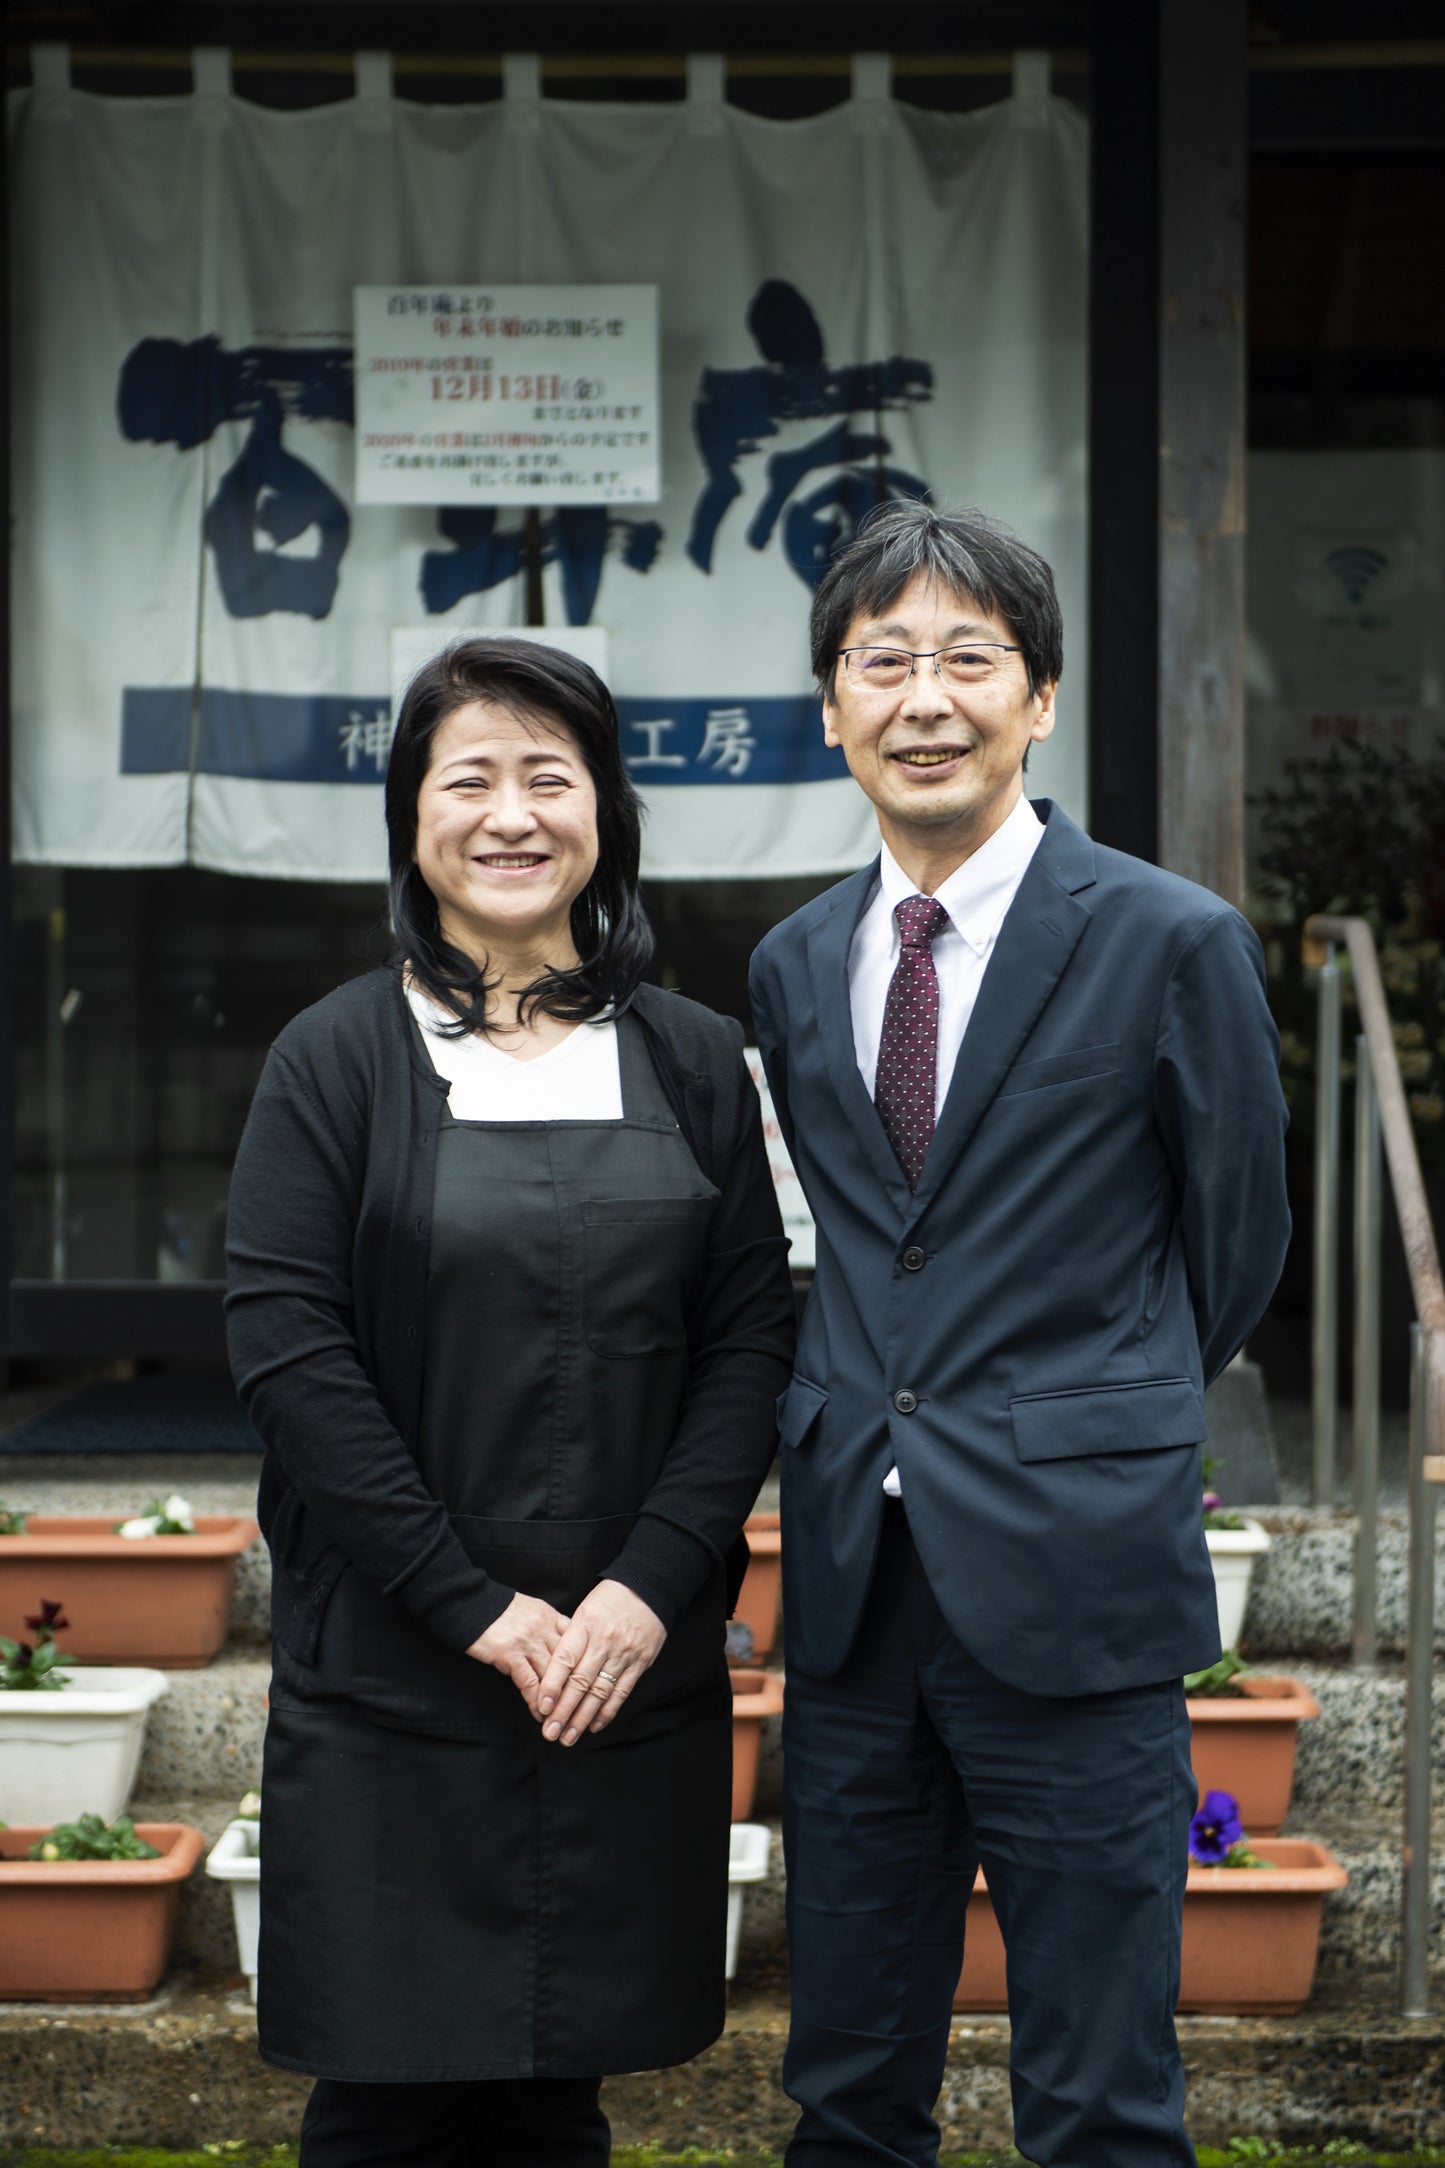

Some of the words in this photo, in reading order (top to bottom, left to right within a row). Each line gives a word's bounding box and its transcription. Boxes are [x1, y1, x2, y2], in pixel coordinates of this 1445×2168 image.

[432, 317, 626, 338] 年末年始のお知らせ
